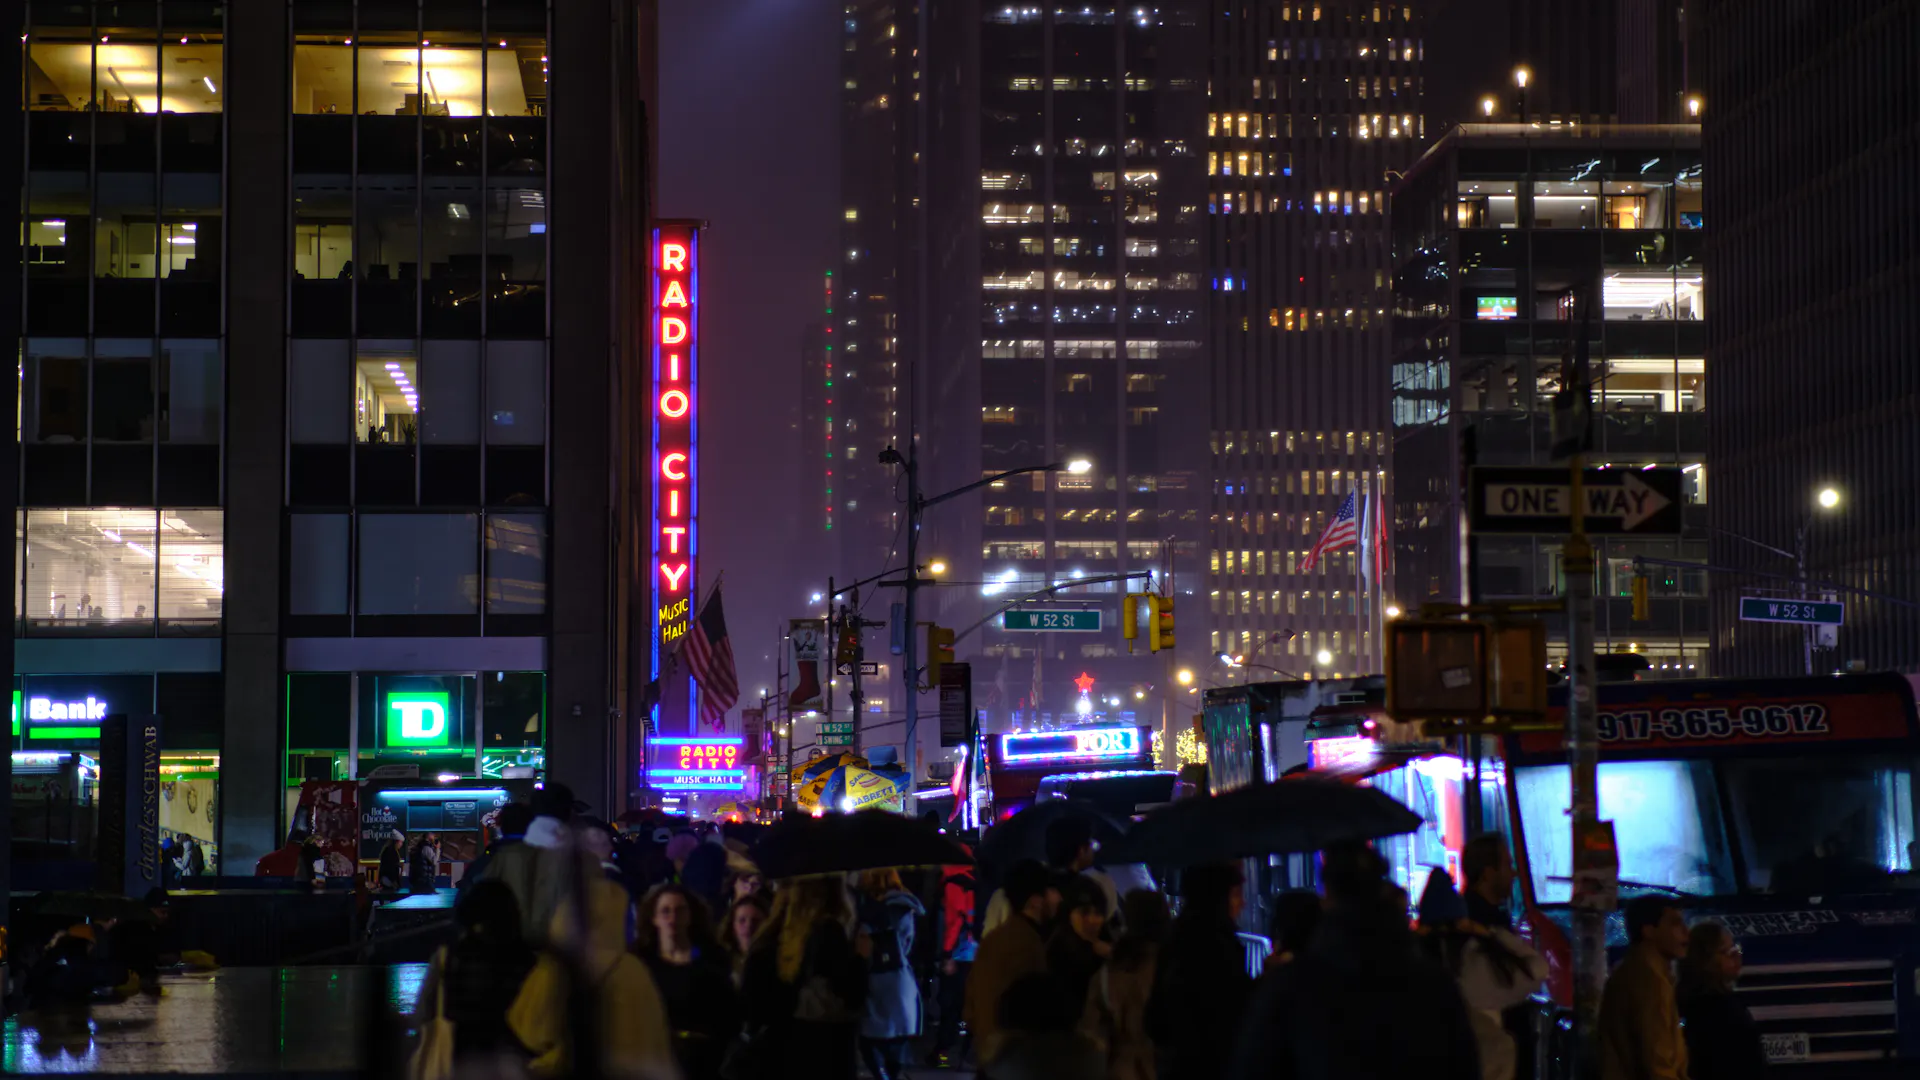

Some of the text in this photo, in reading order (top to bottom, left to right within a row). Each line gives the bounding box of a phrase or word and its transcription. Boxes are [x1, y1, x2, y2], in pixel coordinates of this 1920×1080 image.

[660, 244, 689, 591] RADIO CITY
[1501, 489, 1649, 514] ONE WAY
[659, 598, 689, 626] MUSIC
[1029, 613, 1075, 627] W 52 St
[1769, 603, 1817, 619] W 52 St
[29, 696, 107, 720] Bank
[391, 700, 445, 739] TD
[832, 723, 843, 733] 52
[1595, 702, 1830, 743] 917-365-9612
[680, 745, 737, 757] RADIO
[144, 725, 157, 804] SCHWAB
[680, 758, 736, 769] CITY
[673, 776, 704, 784] MUSIC
[369, 828, 393, 842] Popcor
